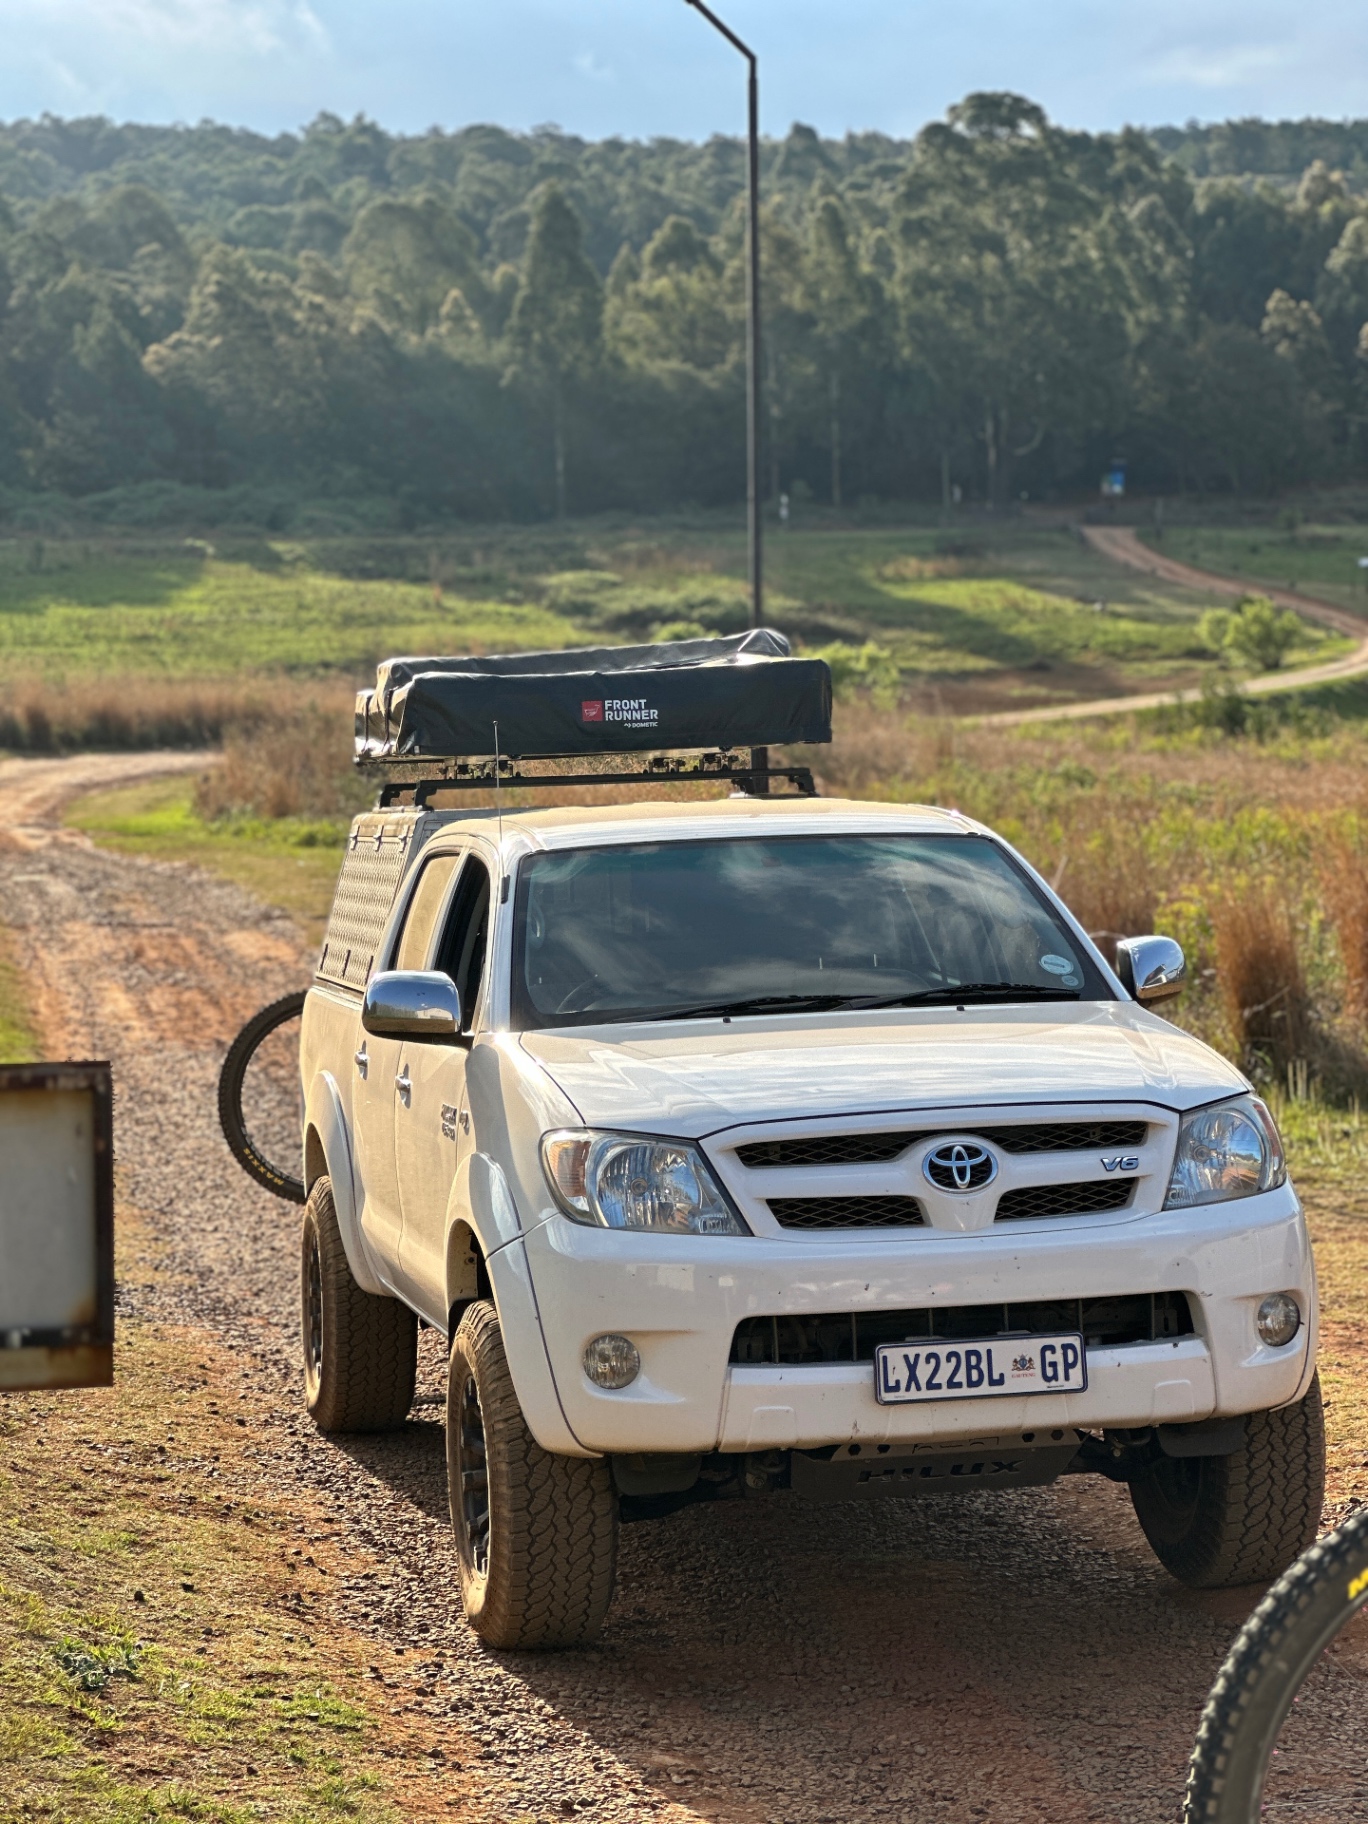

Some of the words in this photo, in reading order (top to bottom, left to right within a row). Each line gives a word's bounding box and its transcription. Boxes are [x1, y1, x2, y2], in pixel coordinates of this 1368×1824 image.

[604, 699, 647, 710] FRONT
[605, 709, 659, 721] RUNNER
[1100, 1155, 1139, 1171] V6
[882, 1348, 1005, 1393] LX22BL
[1040, 1343, 1079, 1383] GP
[856, 1459, 1024, 1484] HILUX
